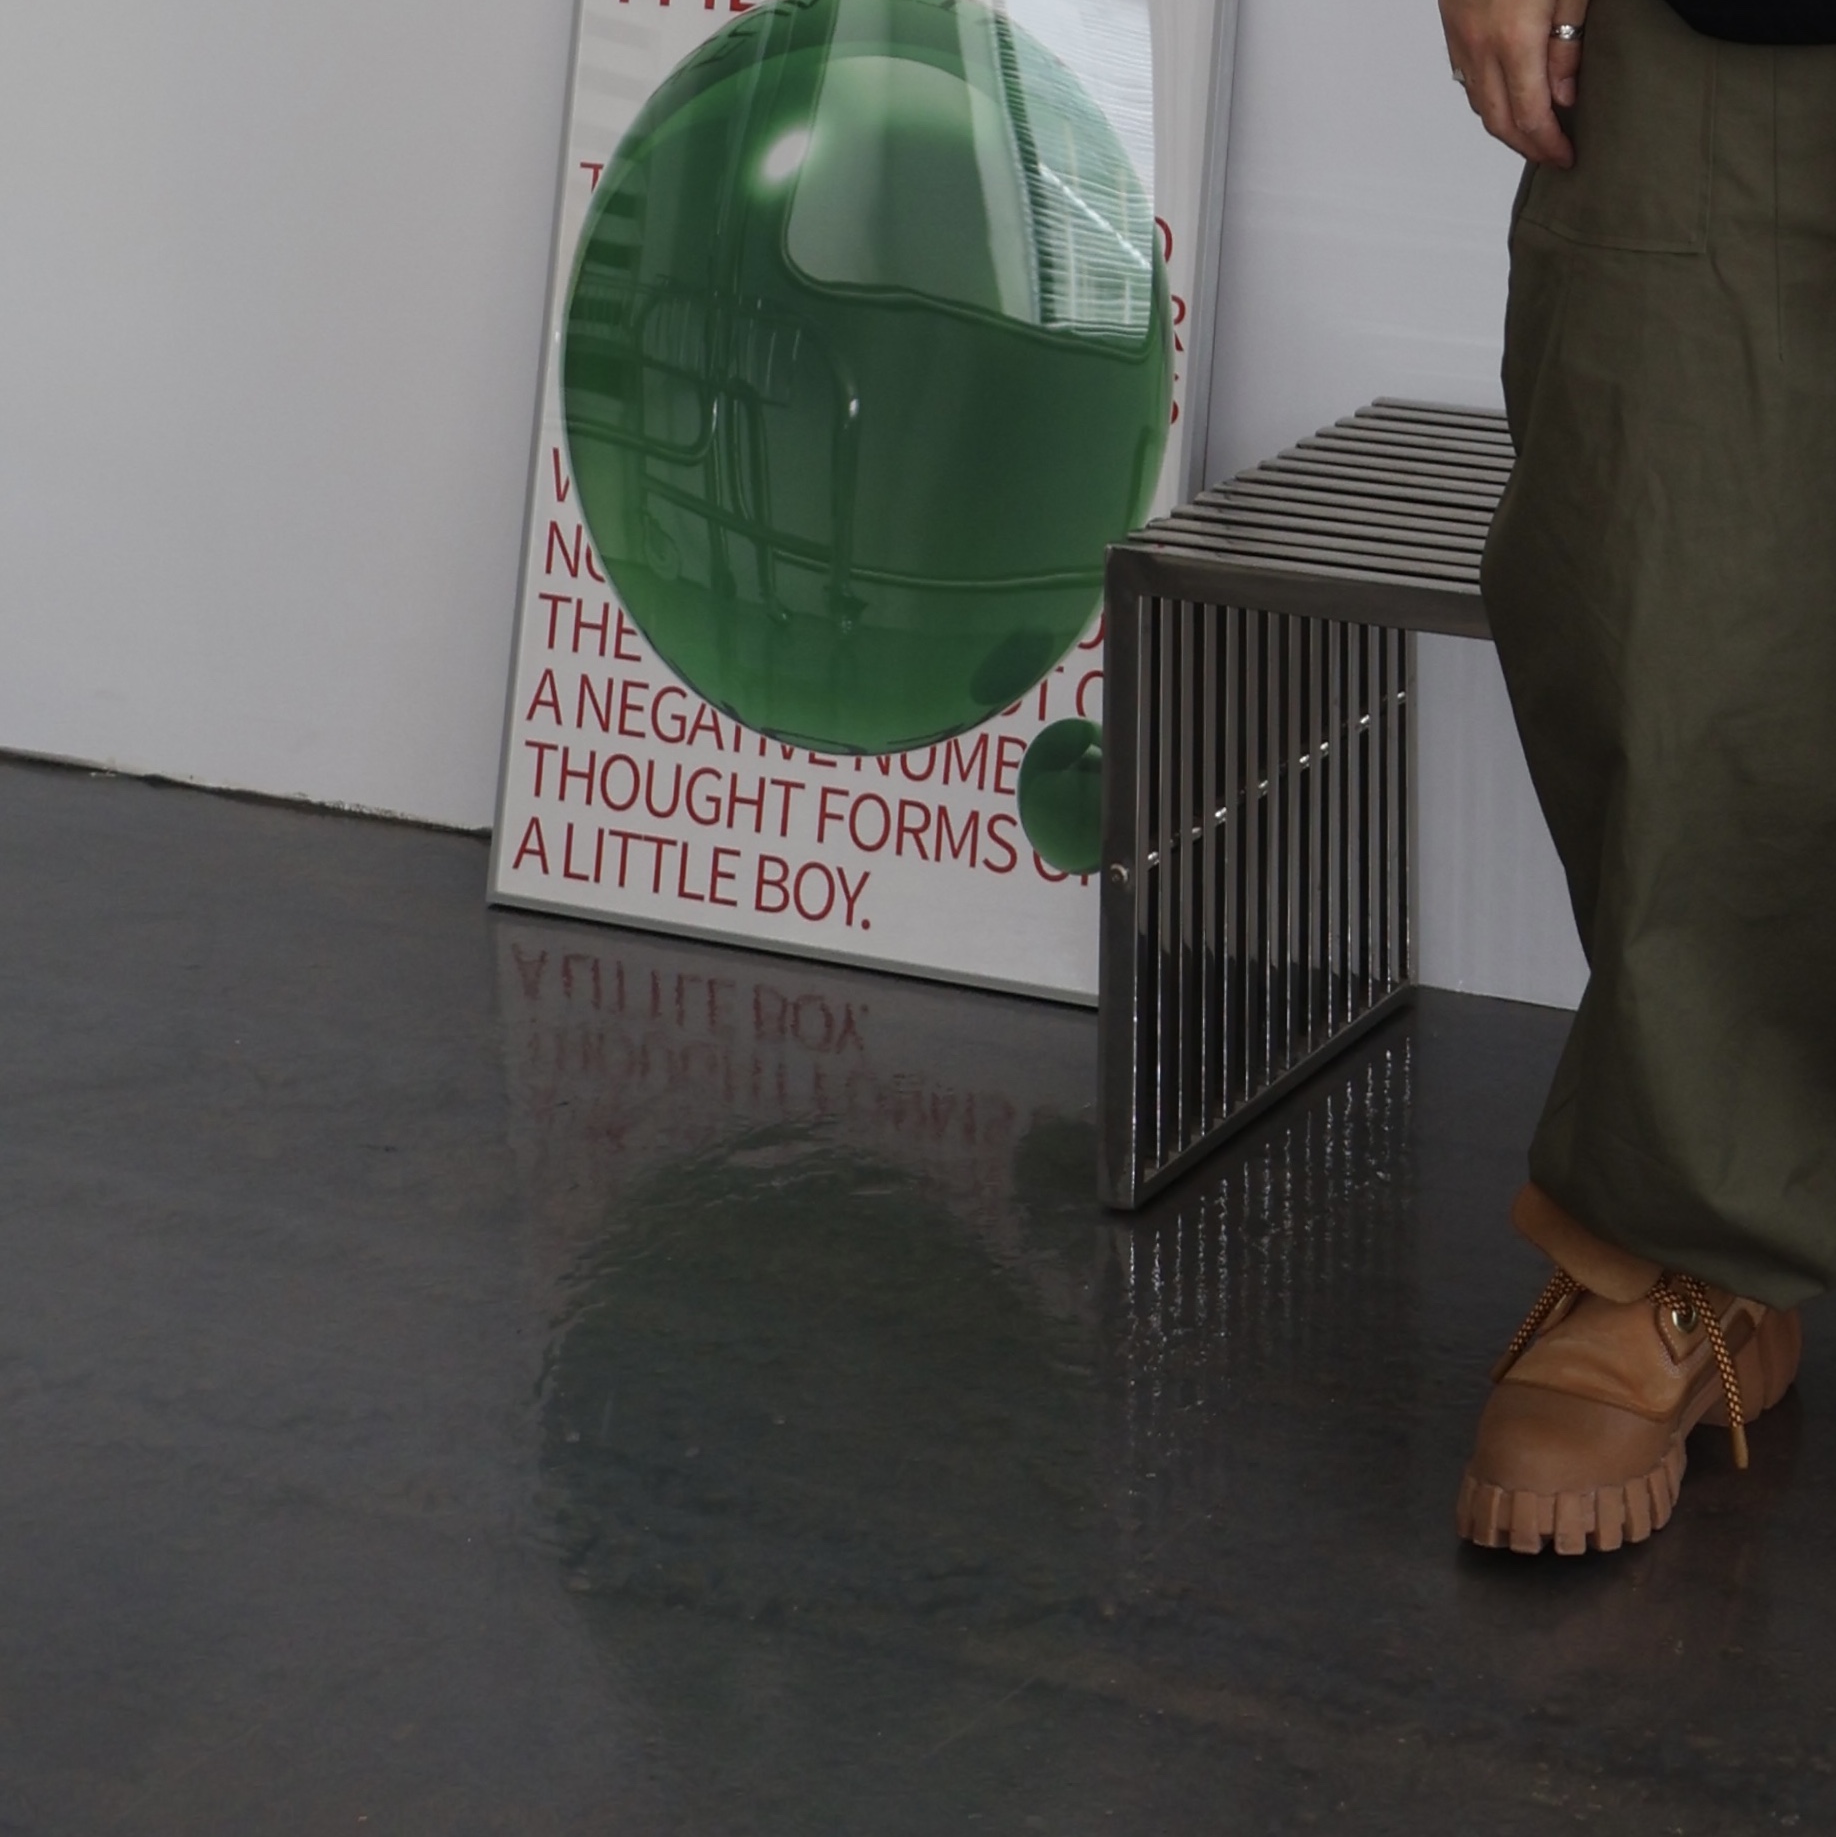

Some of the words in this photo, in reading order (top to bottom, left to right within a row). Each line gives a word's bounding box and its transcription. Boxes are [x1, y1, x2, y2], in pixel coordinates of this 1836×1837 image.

[527, 668, 563, 726] A
[525, 740, 806, 838] THOUGHT
[817, 786, 1018, 875] FORMS
[512, 816, 550, 875] A
[563, 827, 742, 908] LITTLE
[754, 854, 872, 930] BOY.
